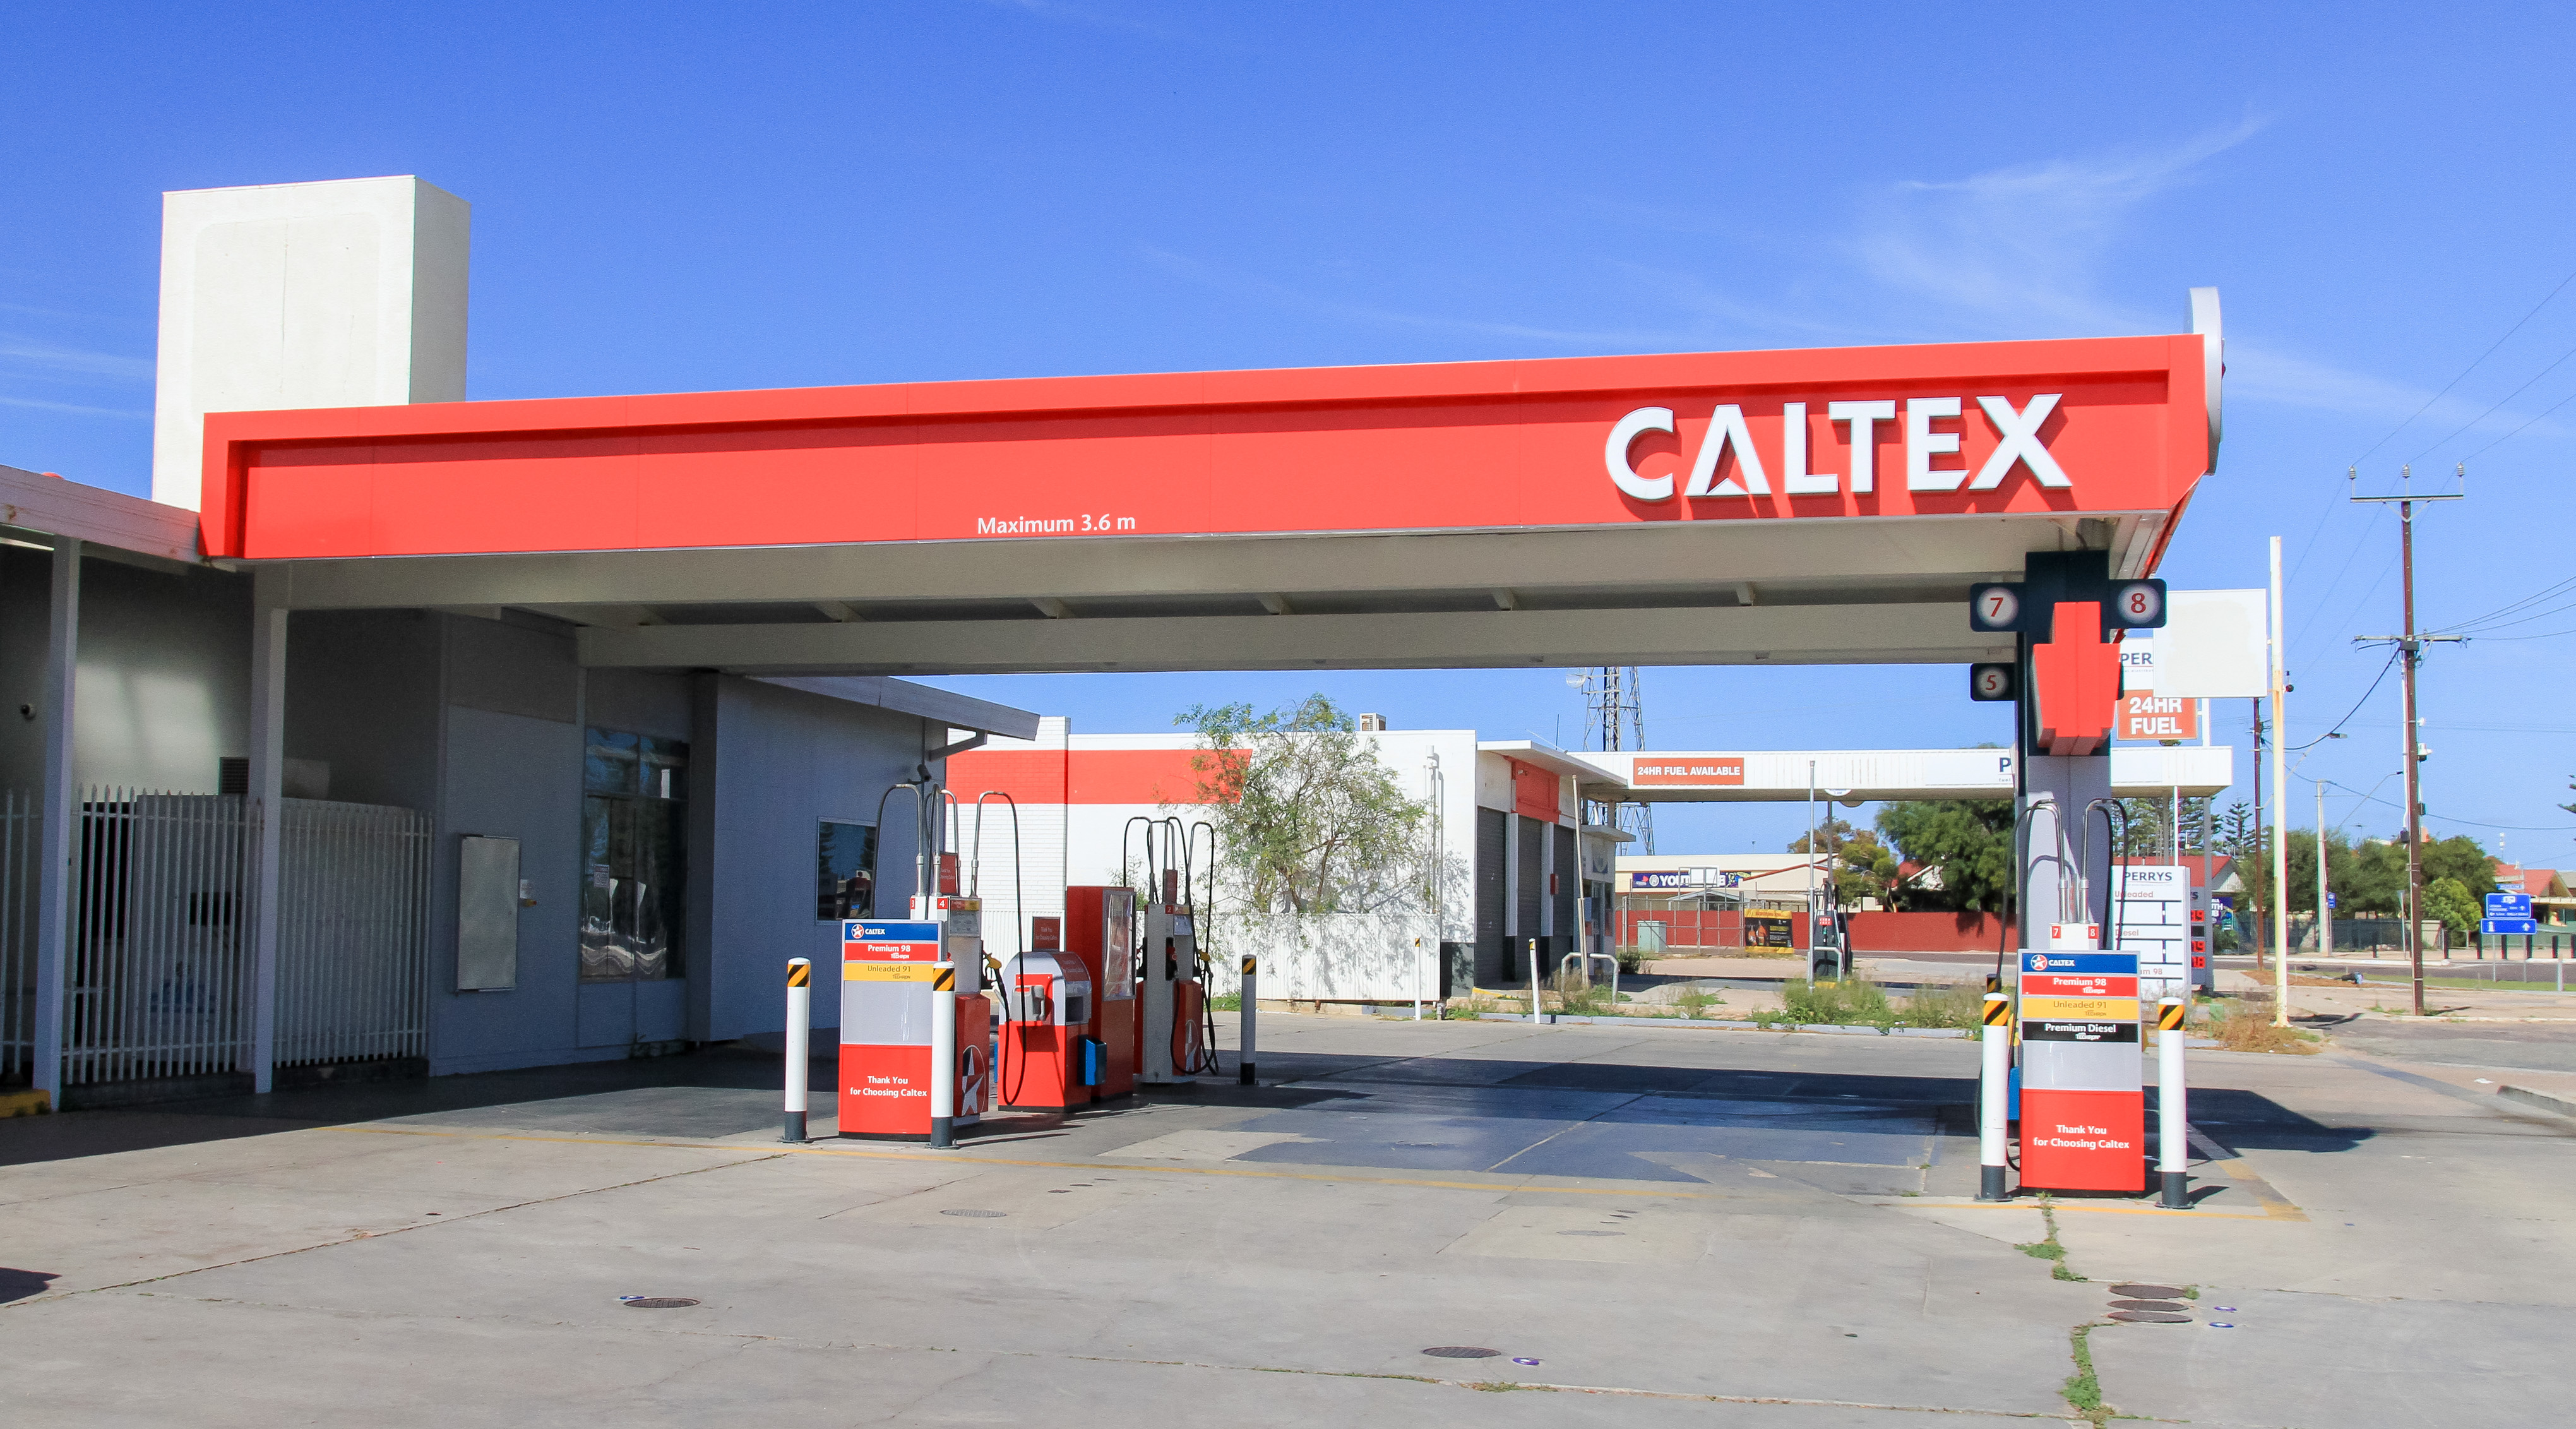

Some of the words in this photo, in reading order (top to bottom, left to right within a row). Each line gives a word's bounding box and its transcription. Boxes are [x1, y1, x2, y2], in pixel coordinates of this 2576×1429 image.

[1605, 393, 2073, 500] CALTEX
[977, 516, 1074, 534] Maximum
[1081, 513, 1111, 532] 3.6
[1117, 516, 1135, 530] m
[1990, 597, 2004, 617] 7
[2130, 592, 2147, 614] 8
[2121, 652, 2154, 665] PER
[1986, 674, 1996, 691] 5
[2129, 697, 2183, 714] 24HR
[2131, 717, 2183, 734] FUEL
[1637, 766, 1662, 776] 24HR
[1664, 766, 1688, 776] FUEL
[1690, 766, 1741, 776] AVAILABLE
[2125, 872, 2173, 881] PERRYS
[2054, 928, 2059, 936] 7
[2090, 928, 2096, 937] 8
[2053, 978, 2093, 986] Premium
[2095, 978, 2107, 986] 98
[2044, 1023, 2086, 1032] Premium
[2088, 1024, 2116, 1033] Diesel
[868, 1075, 891, 1084] Thank
[892, 1076, 909, 1084] You
[850, 1087, 861, 1095] for
[862, 1087, 899, 1098] Choosing
[900, 1089, 927, 1097] Caltex
[2056, 1125, 2085, 1134] Thank
[2087, 1126, 2107, 1135] You
[2033, 1137, 2048, 1146] for
[2050, 1138, 2096, 1150] Choosing
[2098, 1140, 2130, 1149] Caltex
